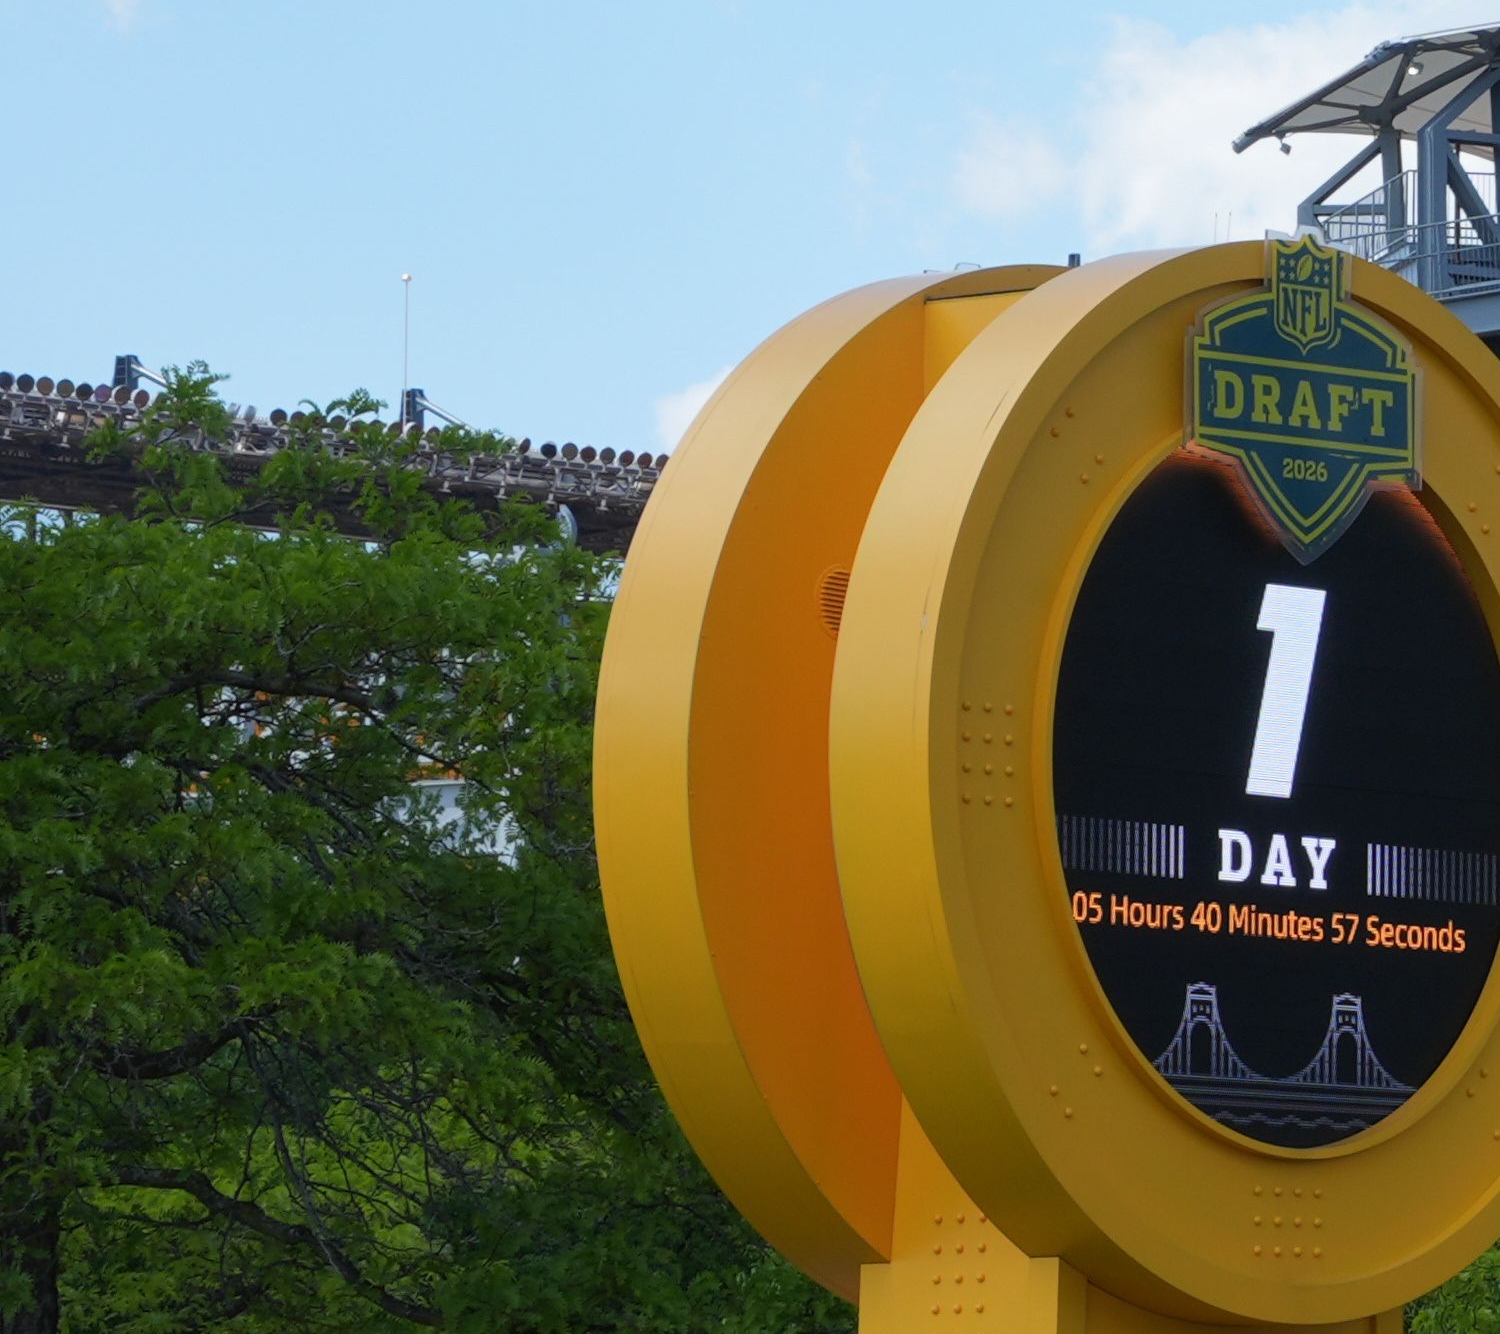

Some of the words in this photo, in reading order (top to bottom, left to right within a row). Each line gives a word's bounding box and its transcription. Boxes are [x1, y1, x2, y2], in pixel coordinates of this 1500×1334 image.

[1281, 287, 1327, 337] NFL
[1213, 370, 1394, 437] DRAFT
[1282, 458, 1329, 482] 2026
[1245, 583, 1327, 799] 1
[1217, 828, 1336, 890] DAY
[1072, 890, 1103, 924] 05
[1110, 894, 1185, 931] Hours
[1191, 901, 1222, 934] 40
[1228, 903, 1325, 942] Minutes
[1331, 913, 1360, 945] 57
[1365, 915, 1467, 954] Seconds
